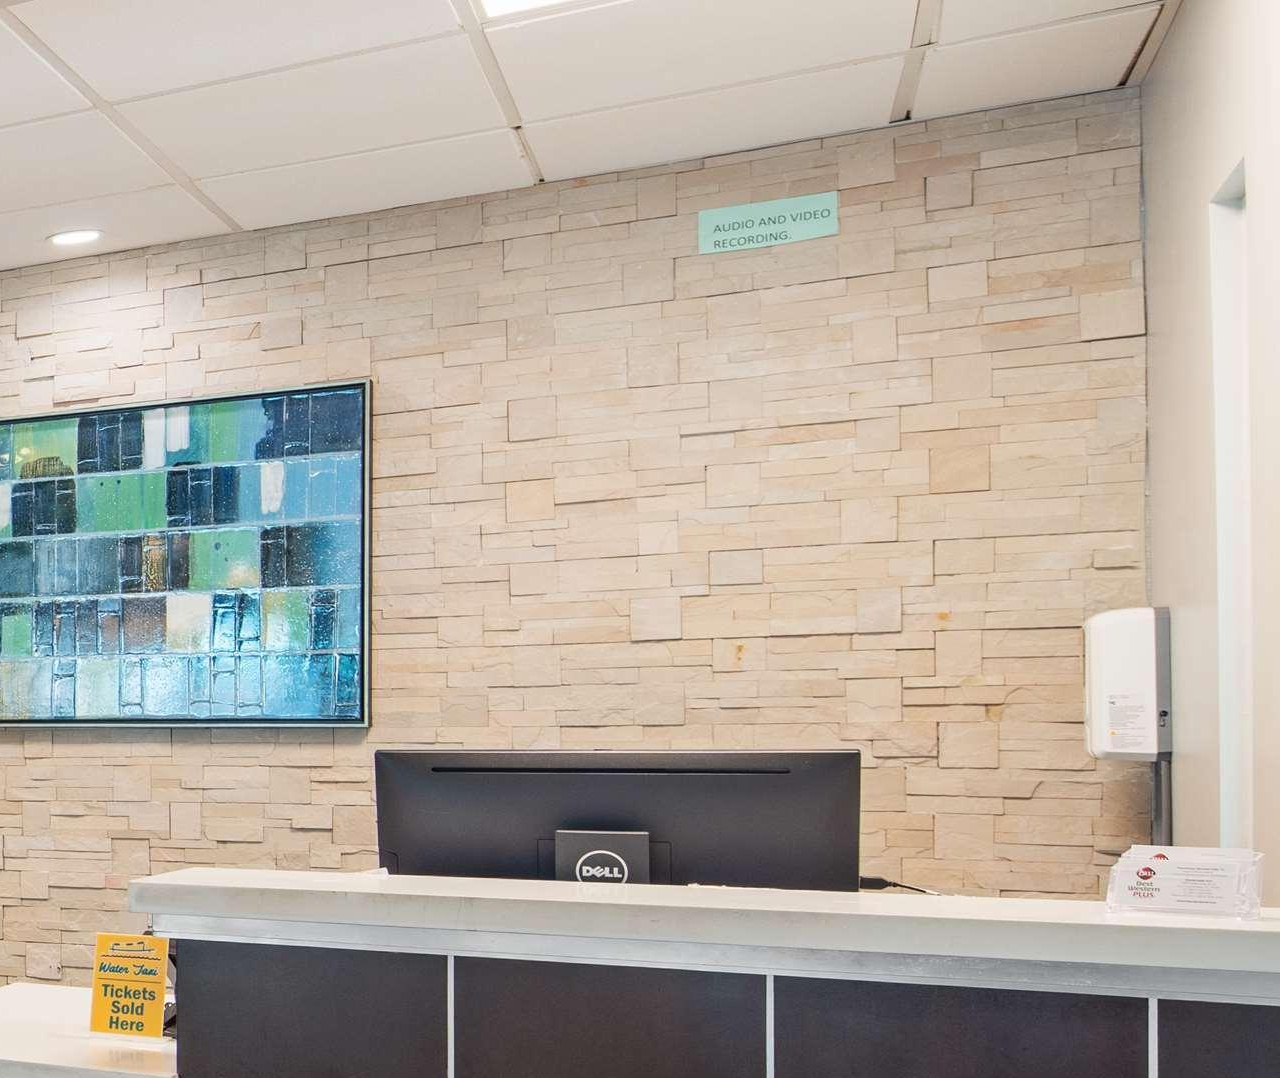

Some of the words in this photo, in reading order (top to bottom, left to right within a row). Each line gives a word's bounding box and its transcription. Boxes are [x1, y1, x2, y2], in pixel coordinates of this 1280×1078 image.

[713, 219, 755, 233] AUDIO
[758, 215, 787, 227] AND
[790, 208, 831, 222] VIDEO
[581, 865, 622, 878] DELL
[98, 961, 129, 974] Water
[132, 963, 159, 976] Taxi
[102, 983, 156, 1000] Tickets
[111, 1000, 144, 1016] Sold
[108, 1016, 144, 1031] Here
